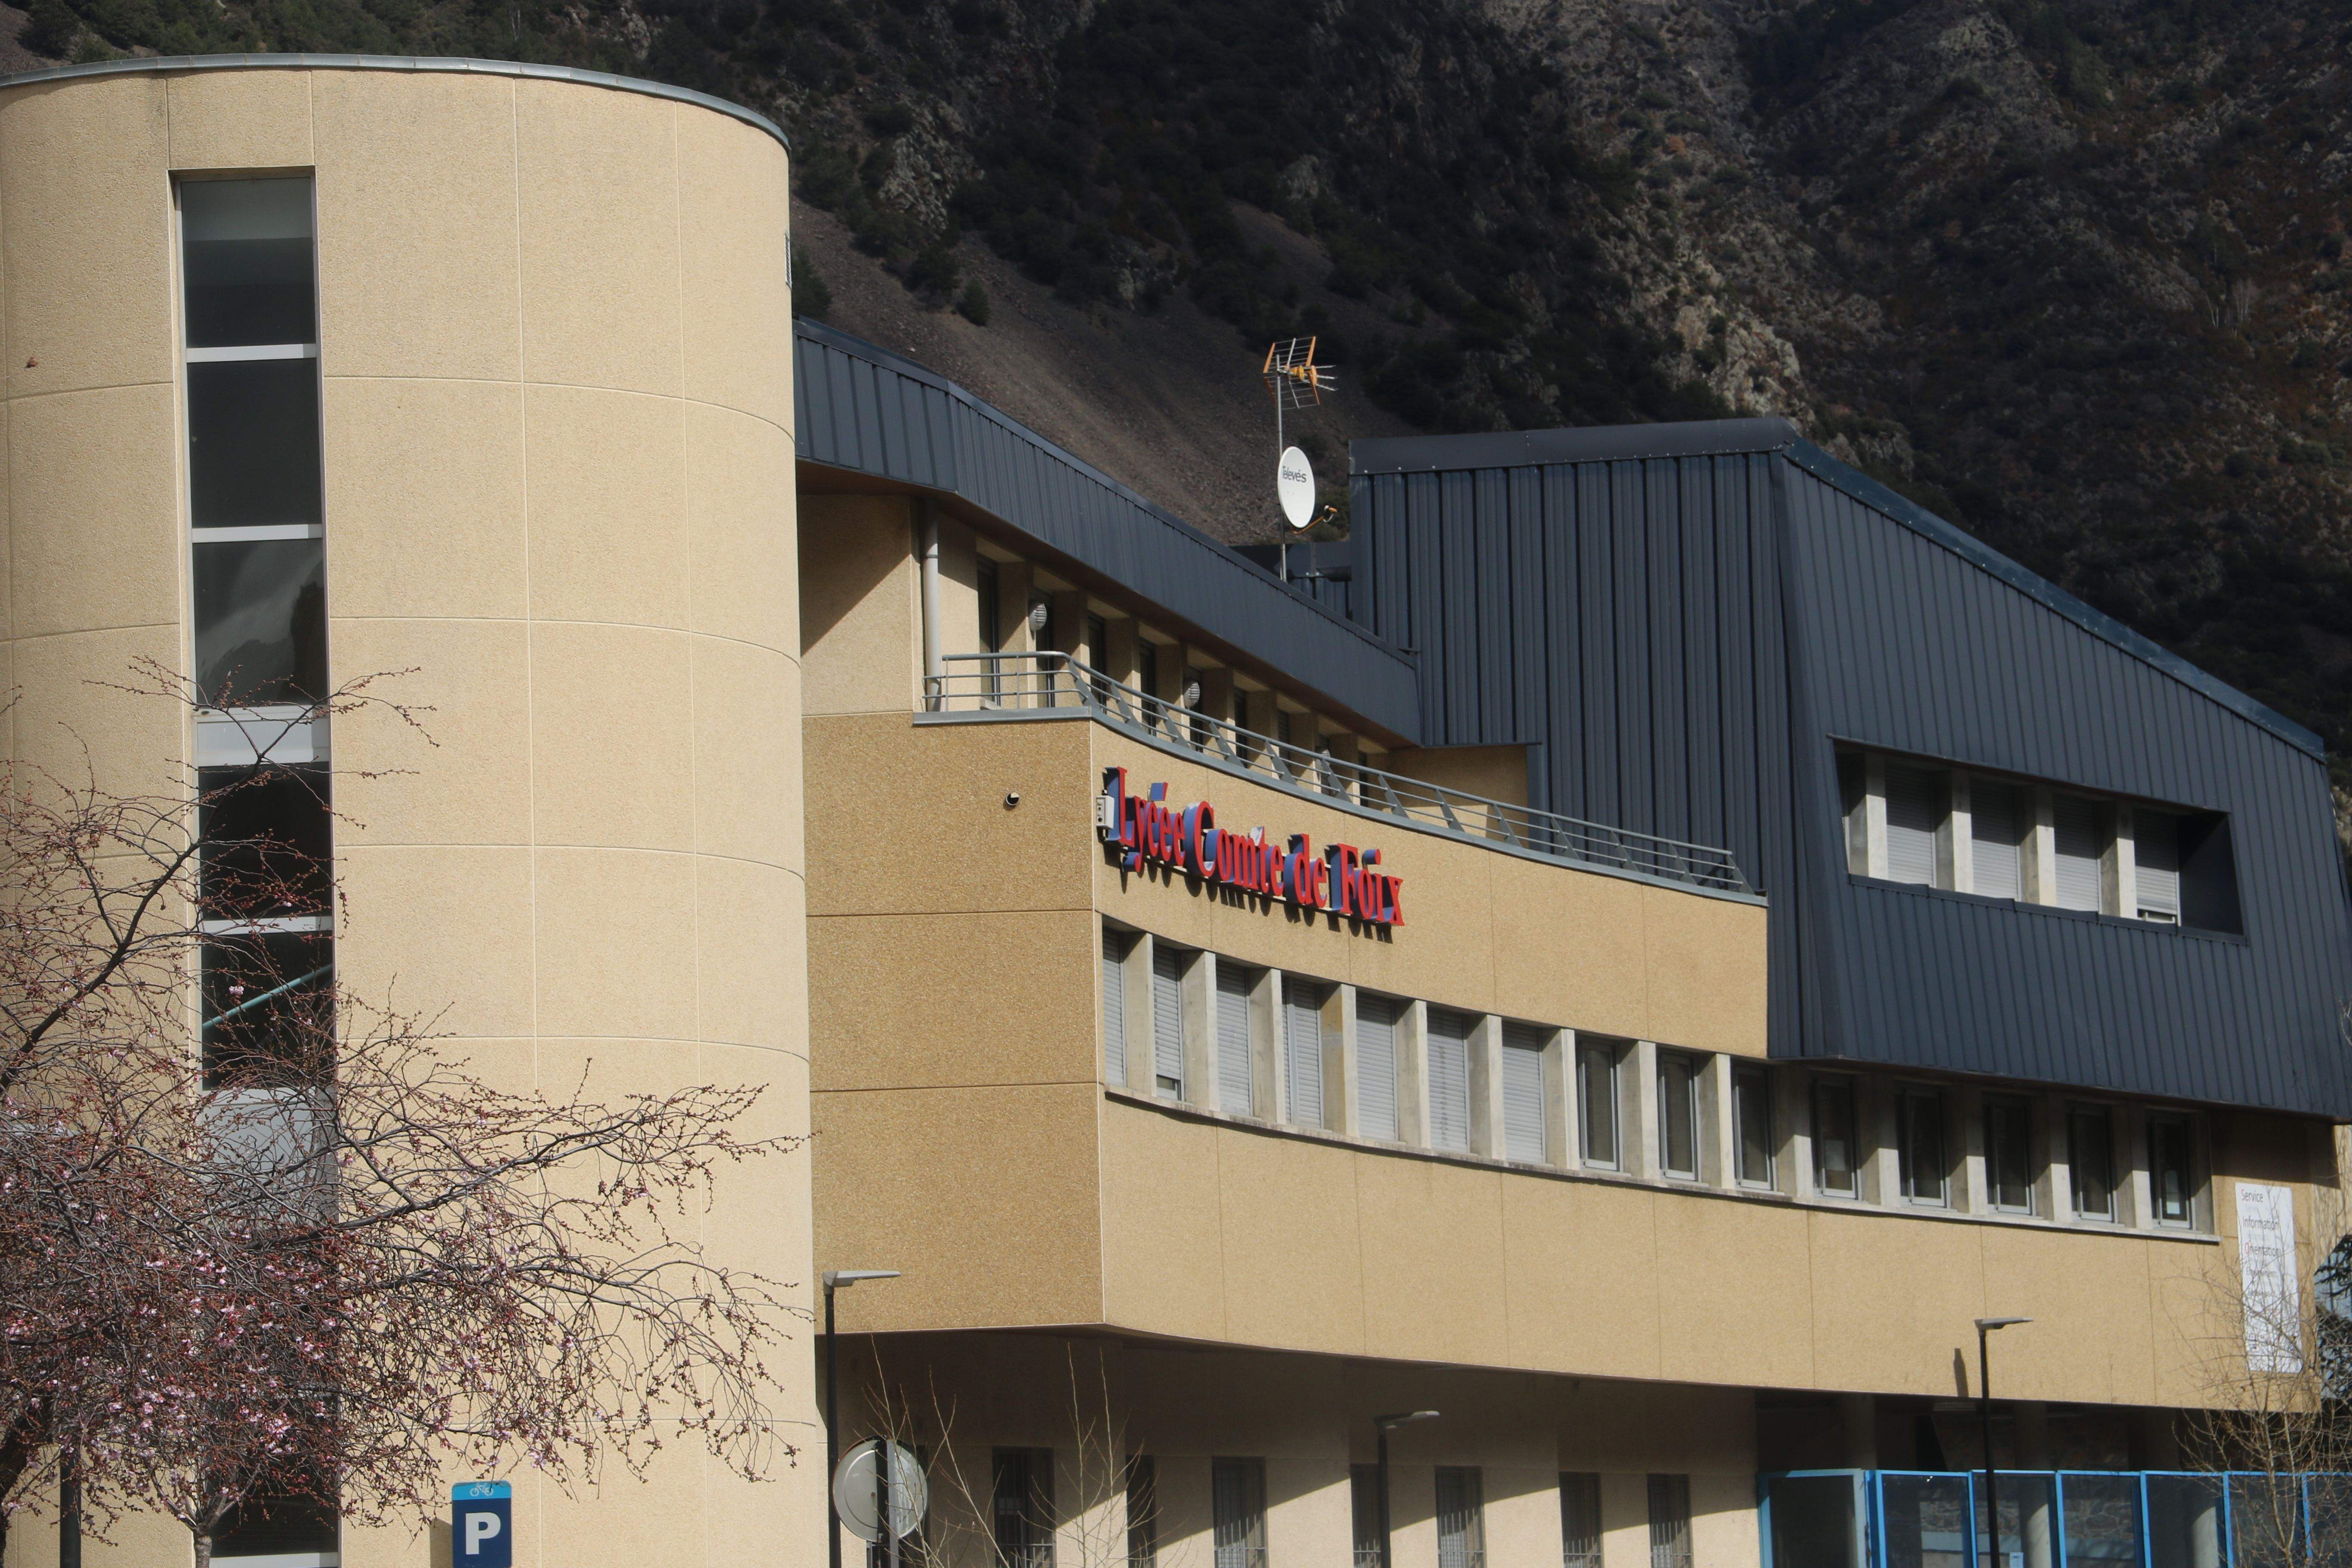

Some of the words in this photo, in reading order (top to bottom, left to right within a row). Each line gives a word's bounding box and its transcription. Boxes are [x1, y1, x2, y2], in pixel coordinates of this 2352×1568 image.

[1283, 466, 1307, 483] Televés
[1106, 766, 1186, 873] Lycée
[1187, 801, 1285, 897] Comte
[1287, 833, 1328, 908] de
[1330, 843, 1405, 926] Foix
[2241, 1188, 2263, 1202] Service
[2242, 1216, 2280, 1230] Information
[466, 1512, 501, 1555] P
